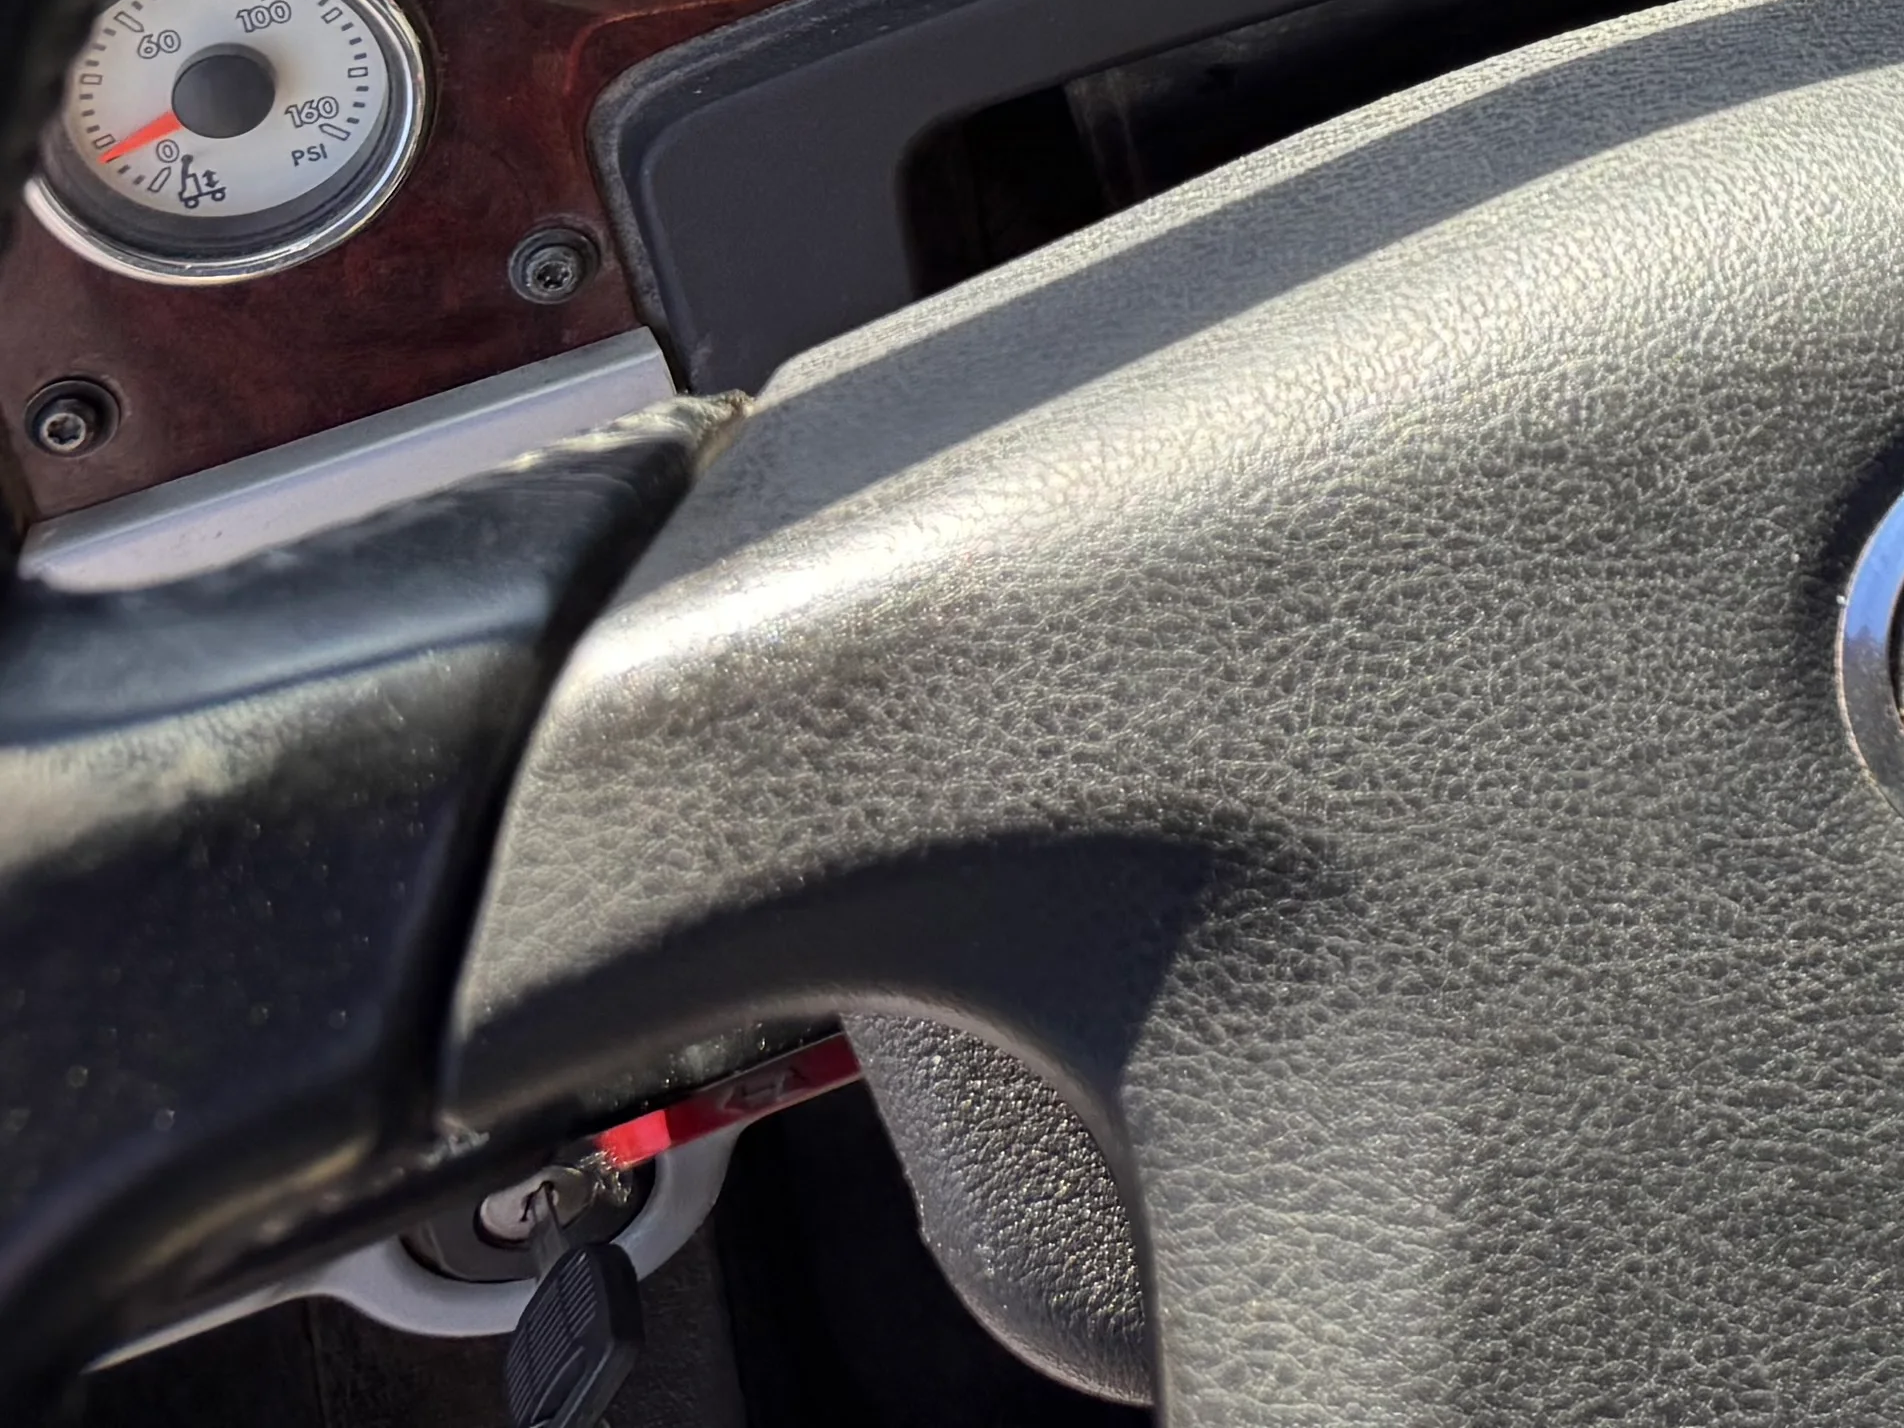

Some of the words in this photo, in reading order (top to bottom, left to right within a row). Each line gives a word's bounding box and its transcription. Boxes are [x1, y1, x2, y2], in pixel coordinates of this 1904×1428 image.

[236, 0, 292, 34] 100
[137, 29, 182, 62] 60
[285, 95, 340, 129] 160
[155, 139, 180, 164] 0
[291, 142, 329, 167] PSI
